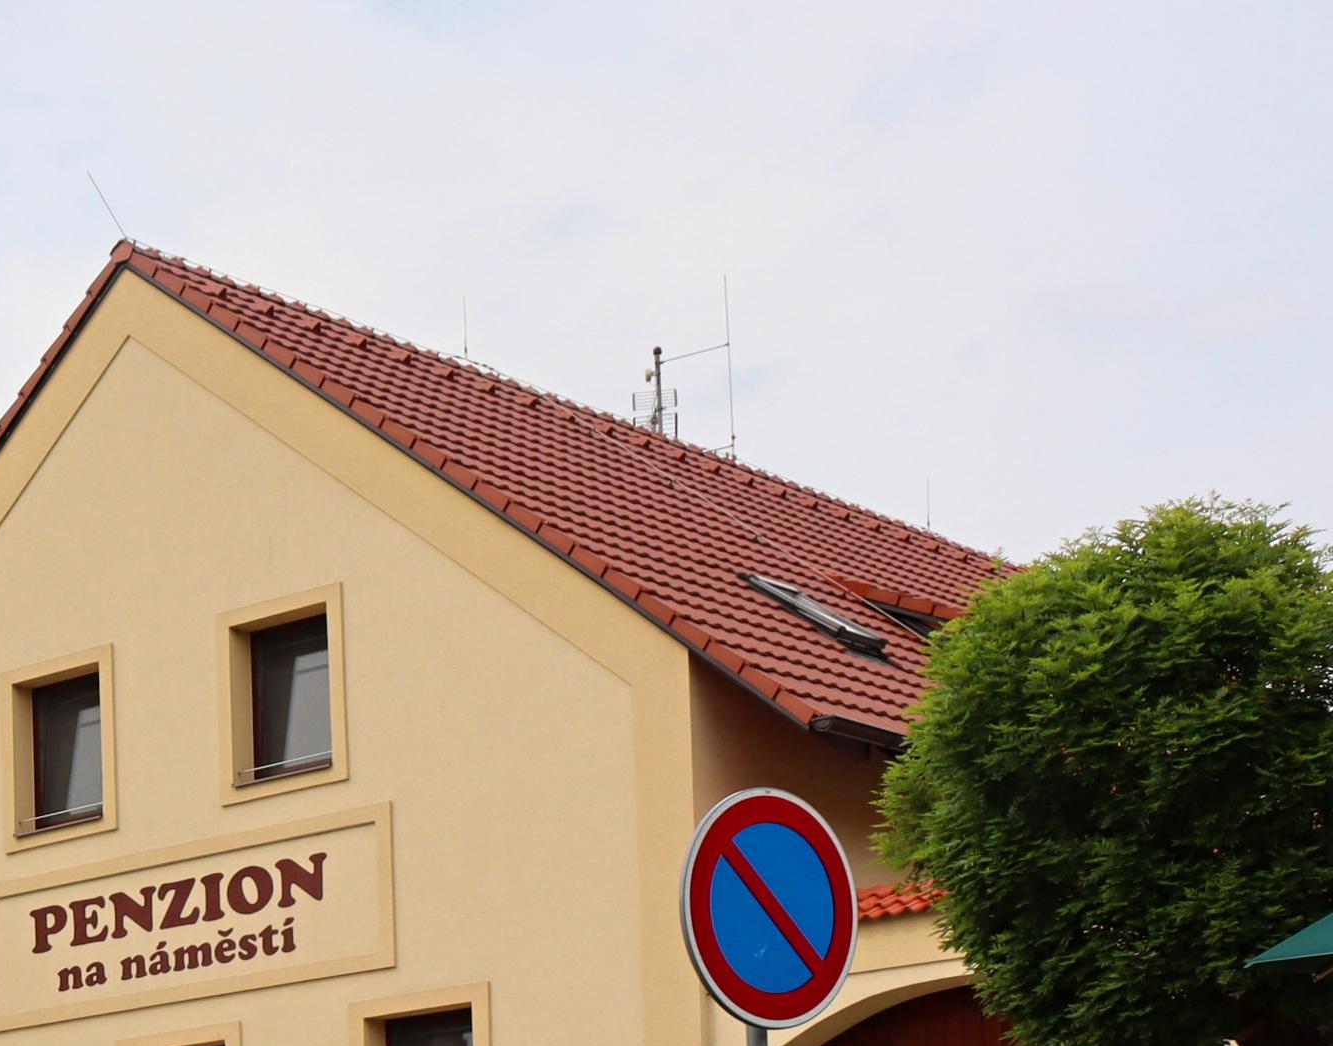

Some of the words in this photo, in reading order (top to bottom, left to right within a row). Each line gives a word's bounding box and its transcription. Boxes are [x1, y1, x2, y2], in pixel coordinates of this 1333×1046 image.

[29, 852, 327, 954] PENZION
[57, 961, 107, 992] na
[120, 916, 296, 981] náměstí
